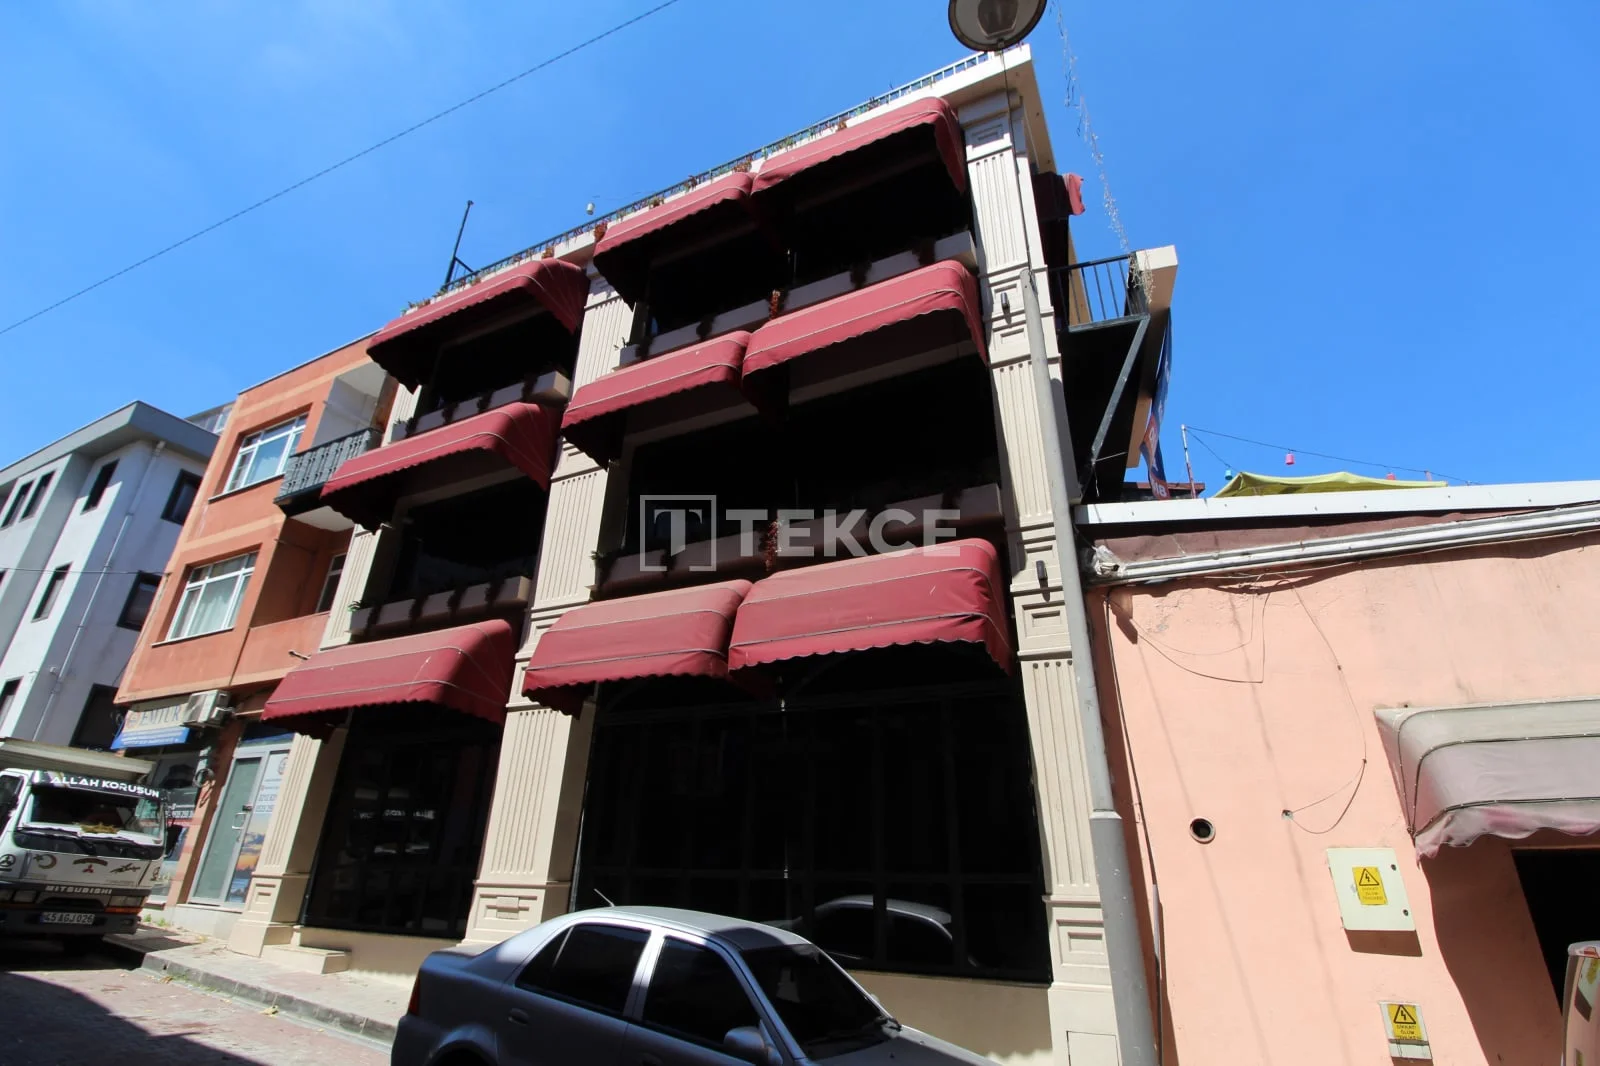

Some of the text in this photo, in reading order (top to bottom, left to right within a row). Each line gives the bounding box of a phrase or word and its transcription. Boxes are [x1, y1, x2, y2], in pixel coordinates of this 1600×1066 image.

[50, 776, 160, 798] ALLAH KORUSUN
[45, 885, 113, 895] MITSUBISHI
